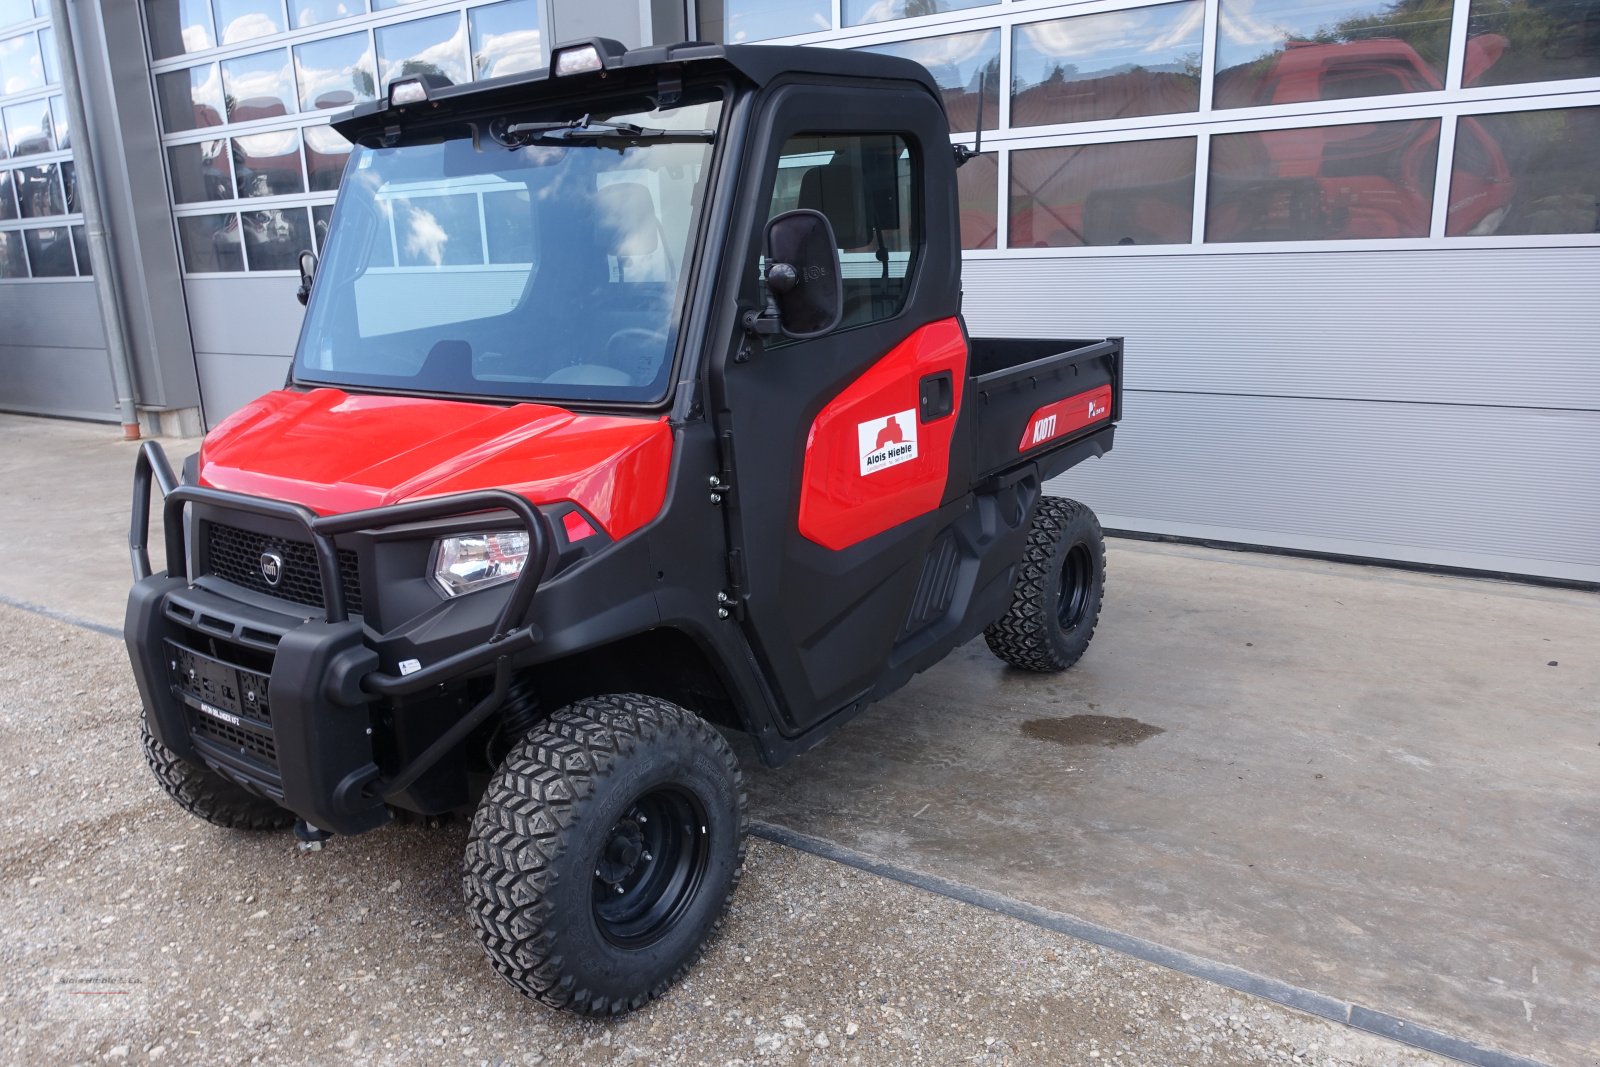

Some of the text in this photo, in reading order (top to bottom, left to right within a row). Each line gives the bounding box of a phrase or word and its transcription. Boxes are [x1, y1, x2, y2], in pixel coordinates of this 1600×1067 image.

[1033, 414, 1057, 444] KIOTI
[867, 453, 887, 466] Alois
[888, 444, 912, 459] Hieble
